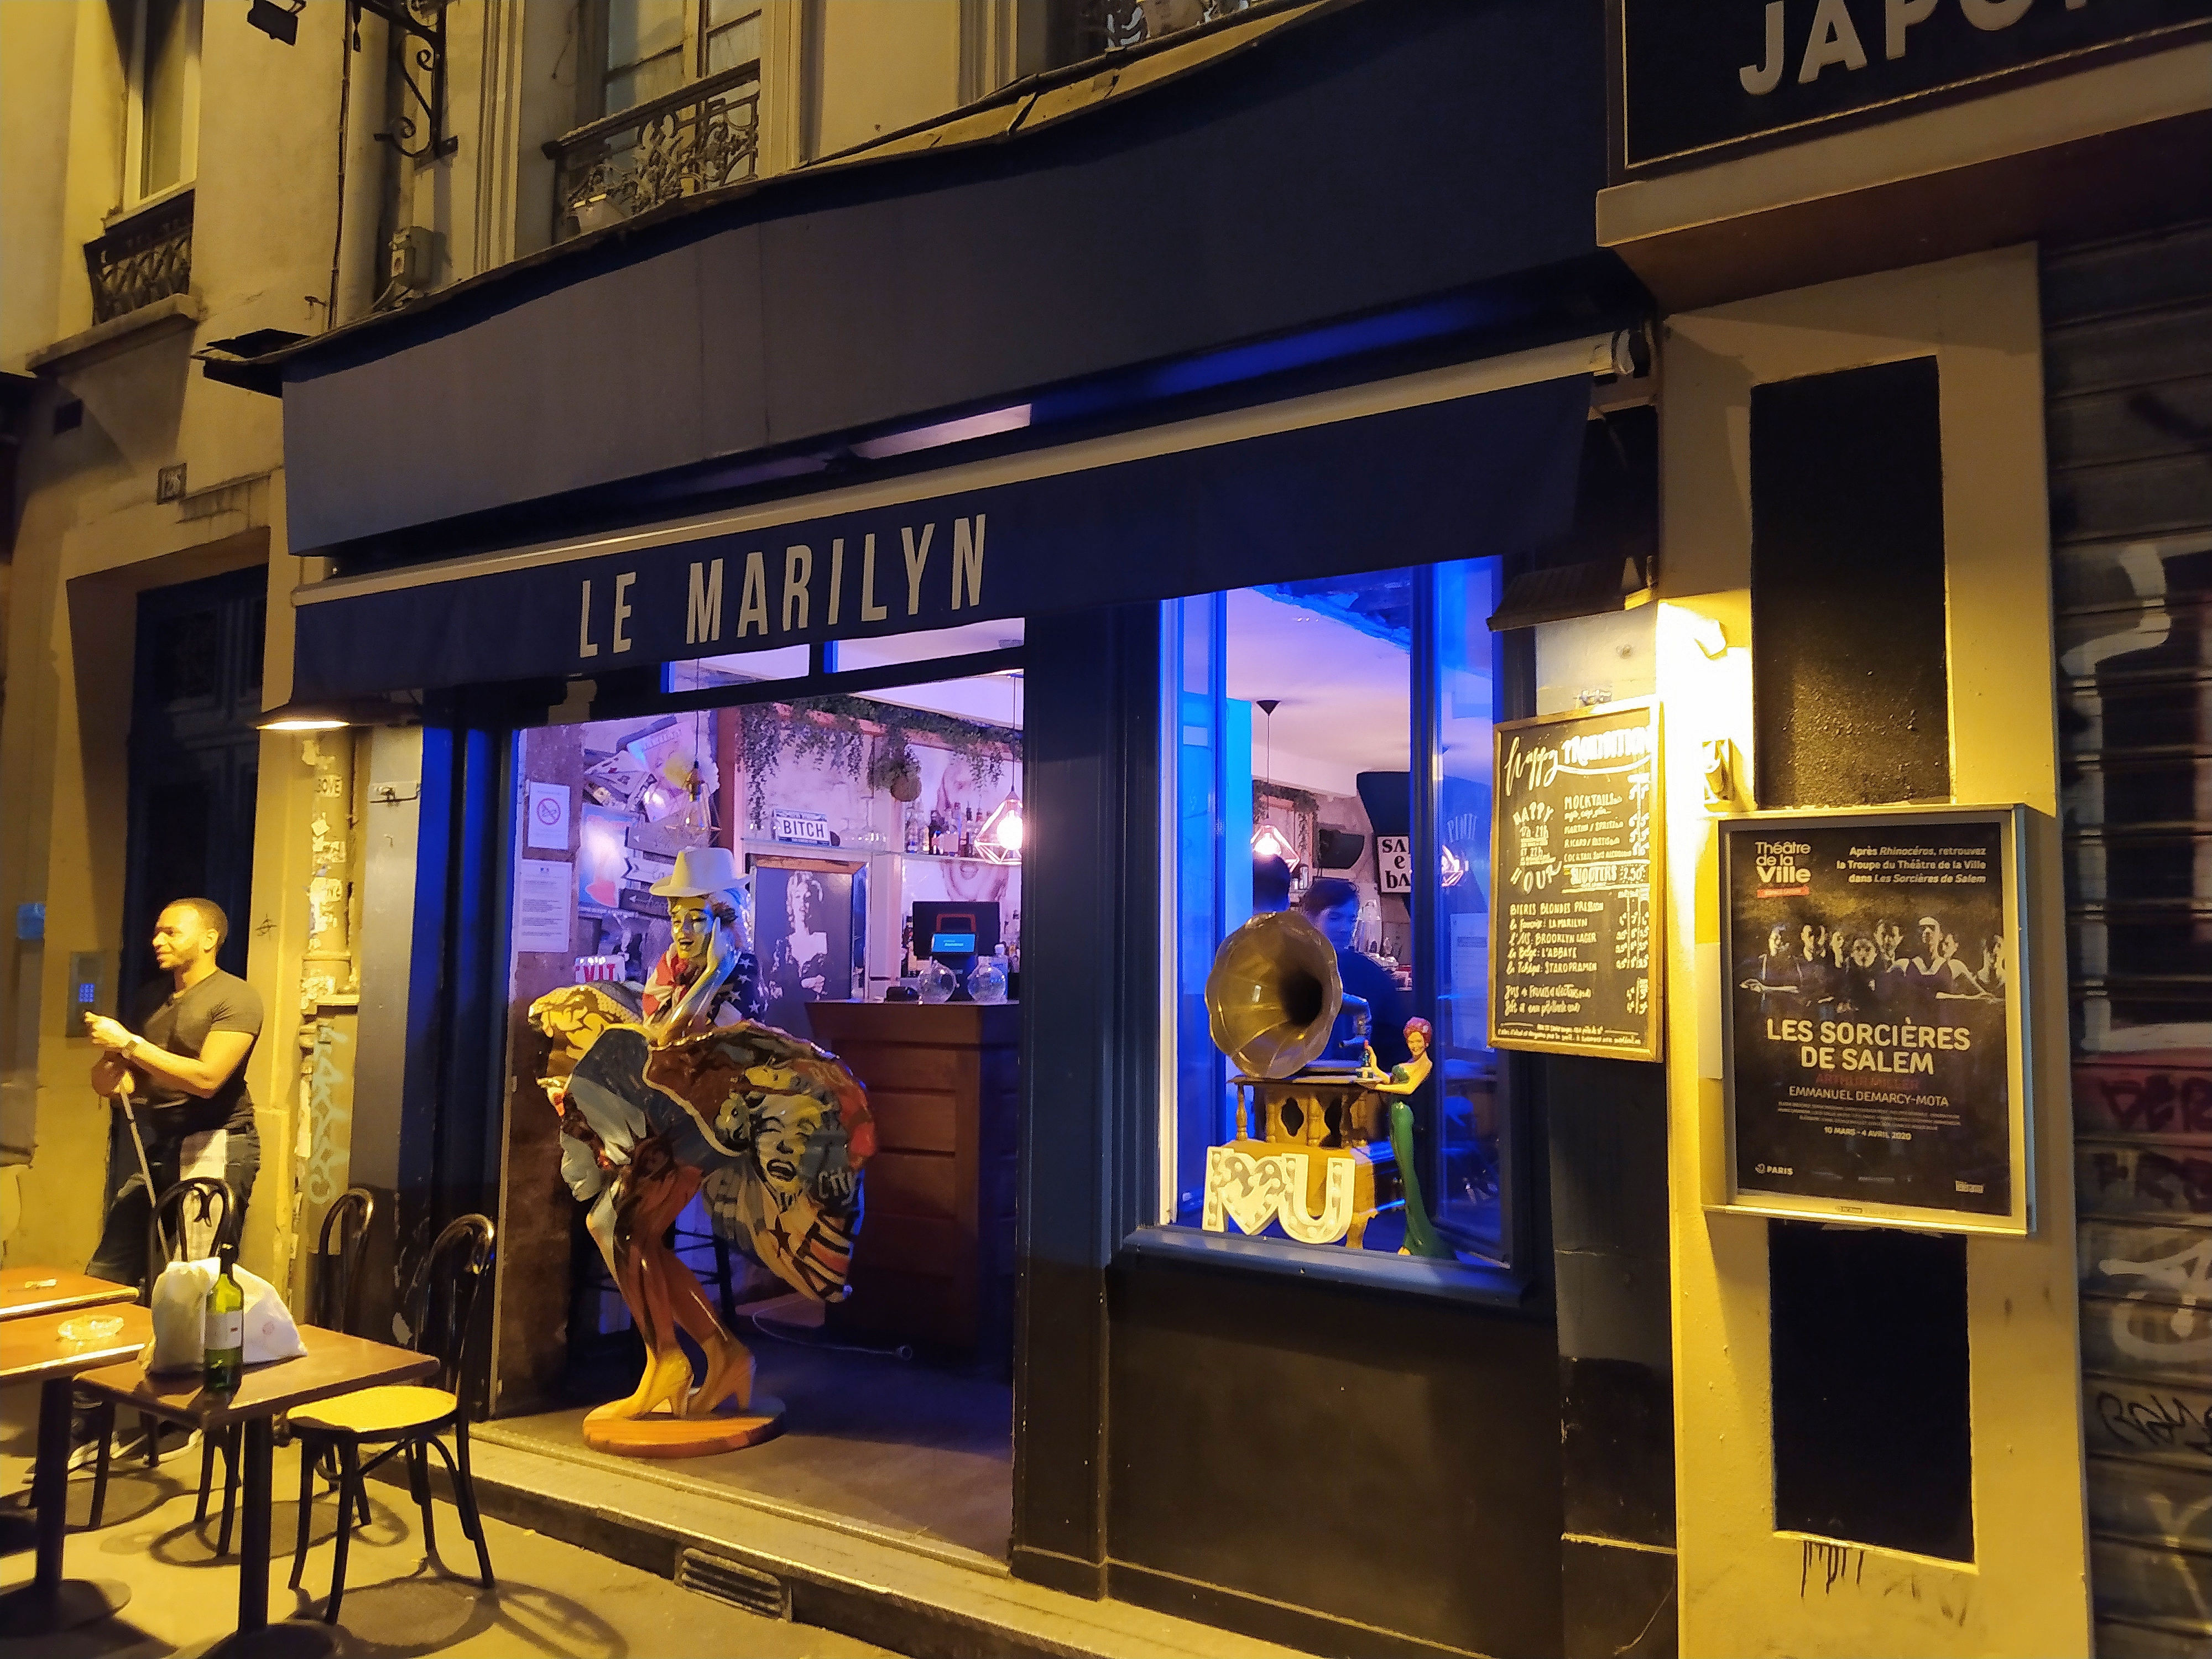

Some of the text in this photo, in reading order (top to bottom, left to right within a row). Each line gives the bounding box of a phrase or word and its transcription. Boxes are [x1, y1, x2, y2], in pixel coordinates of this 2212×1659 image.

[578, 513, 987, 659] LE MARILYN
[1512, 801, 1554, 826] HAPPY
[783, 819, 825, 838] BITCH
[1755, 841, 1811, 854] Théâtre
[1849, 846, 1877, 858] Après
[1938, 847, 1987, 856] retrouvez
[1756, 854, 1793, 866] de la
[1837, 859, 1986, 871] la Troupe du Théâtre de la Ville
[1756, 866, 1811, 883] Ville
[1848, 873, 1987, 884] dans Les Sorcières de Salem
[1767, 1016, 1971, 1051] LES SORCIÈRES
[1801, 1046, 1934, 1076] DE SALEM
[1788, 1086, 1949, 1107] EMMANUEL DEMARCY-MOTA
[1834, 1127, 1856, 1136] MARS
[1867, 1129, 1890, 1138] AVRIL
[1766, 1165, 1794, 1176] PARIS
